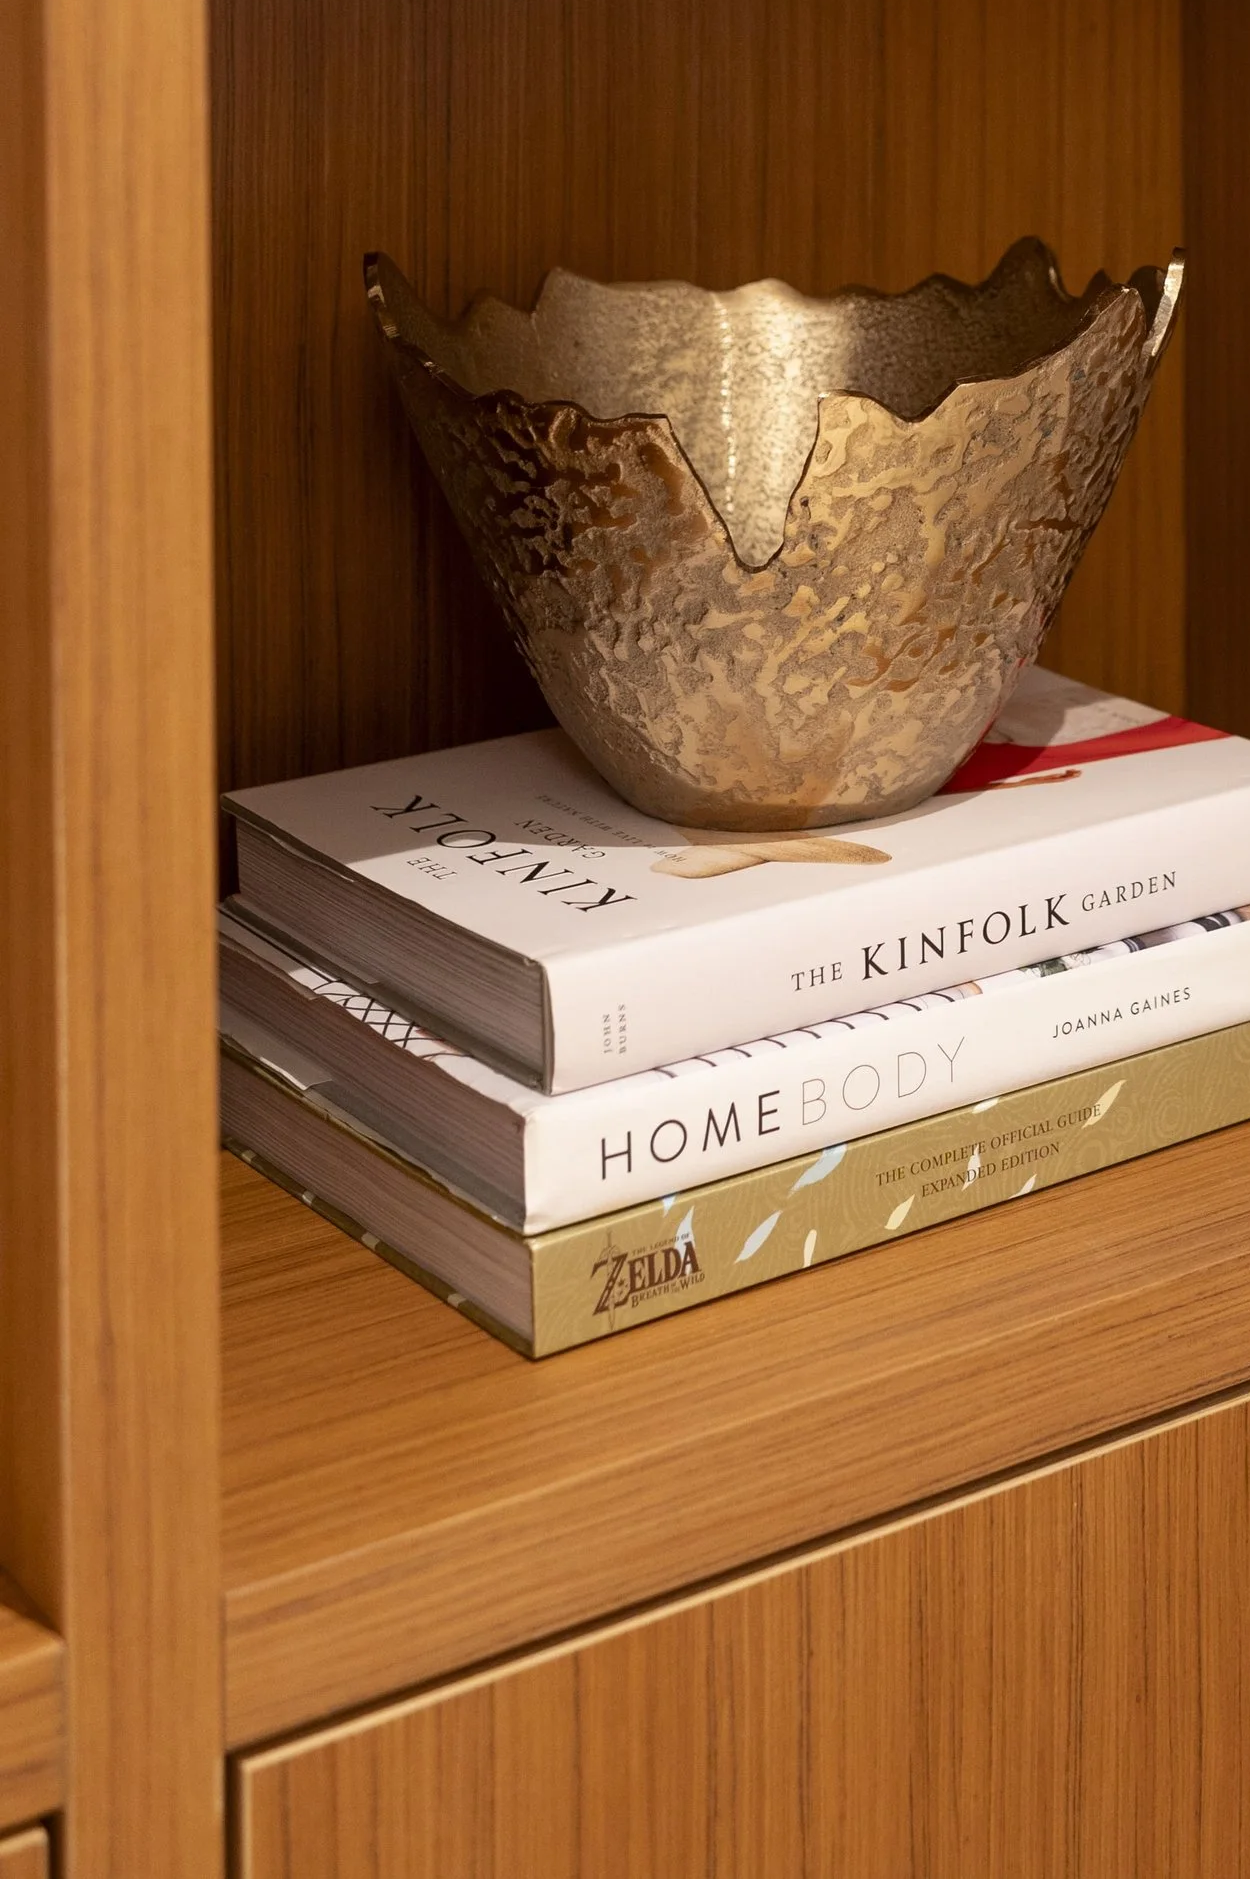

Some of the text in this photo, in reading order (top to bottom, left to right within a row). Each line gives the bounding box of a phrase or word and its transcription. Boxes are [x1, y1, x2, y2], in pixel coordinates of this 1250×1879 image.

[369, 794, 638, 912] KINFOLK
[514, 818, 606, 860] GARDEN
[407, 856, 457, 880] THE
[791, 870, 1178, 992] THE KINFOLK GARDEN
[603, 1013, 613, 1054] JOHN
[618, 1003, 627, 1055] BURNS
[1052, 986, 1192, 1039] JOANNA GAINES
[875, 1103, 1102, 1187] THE COMPLETE OFFICIAL GUIDE
[921, 1140, 1062, 1198] EXPANDED EDITION
[589, 1240, 703, 1316] ZELDA
[630, 1283, 670, 1309] BREATH
[680, 1272, 706, 1291] WILD
